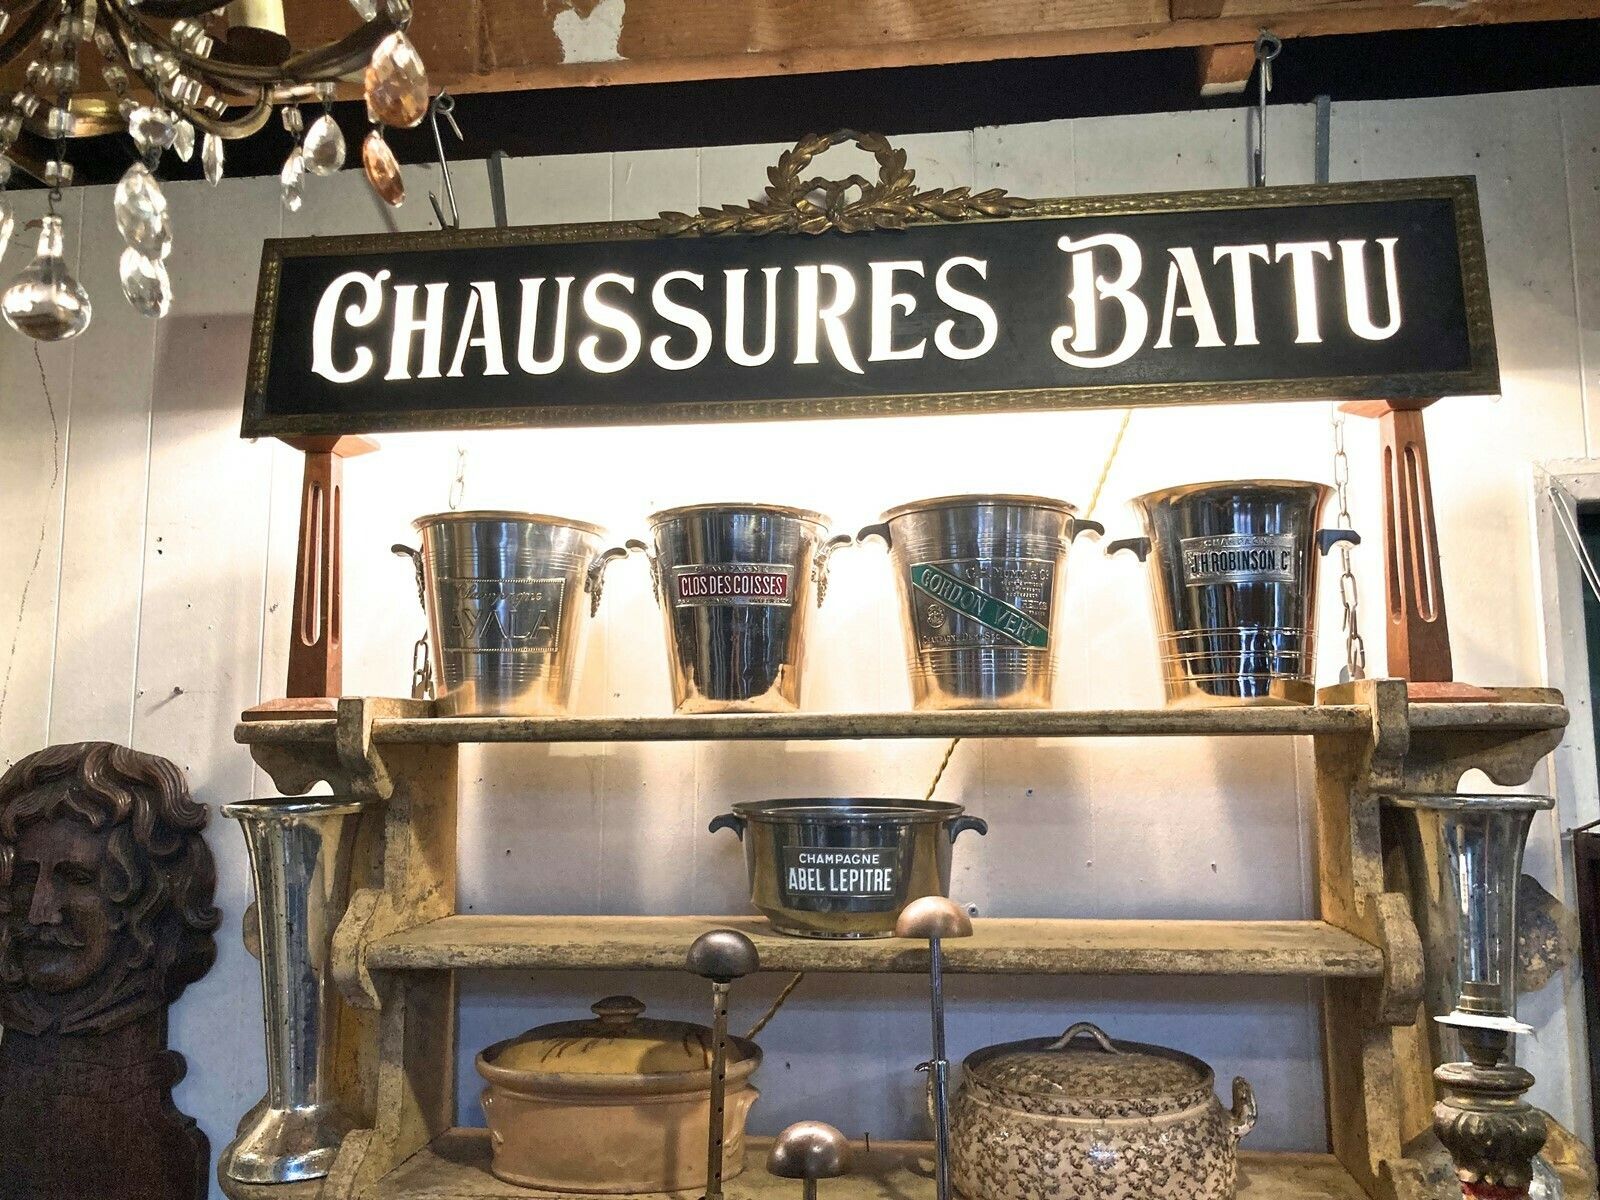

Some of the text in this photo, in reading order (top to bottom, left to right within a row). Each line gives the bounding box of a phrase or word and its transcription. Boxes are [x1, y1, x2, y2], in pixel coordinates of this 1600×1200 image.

[311, 233, 1402, 384] CHAUSSURES BATTU
[1211, 550, 1275, 572] ROBINSON
[681, 575, 708, 597] CLOS
[709, 575, 732, 595] DES
[994, 604, 1040, 644] VERT
[799, 853, 880, 865] CHAMPAGNE
[788, 866, 893, 892] ABEL LEPITRE
